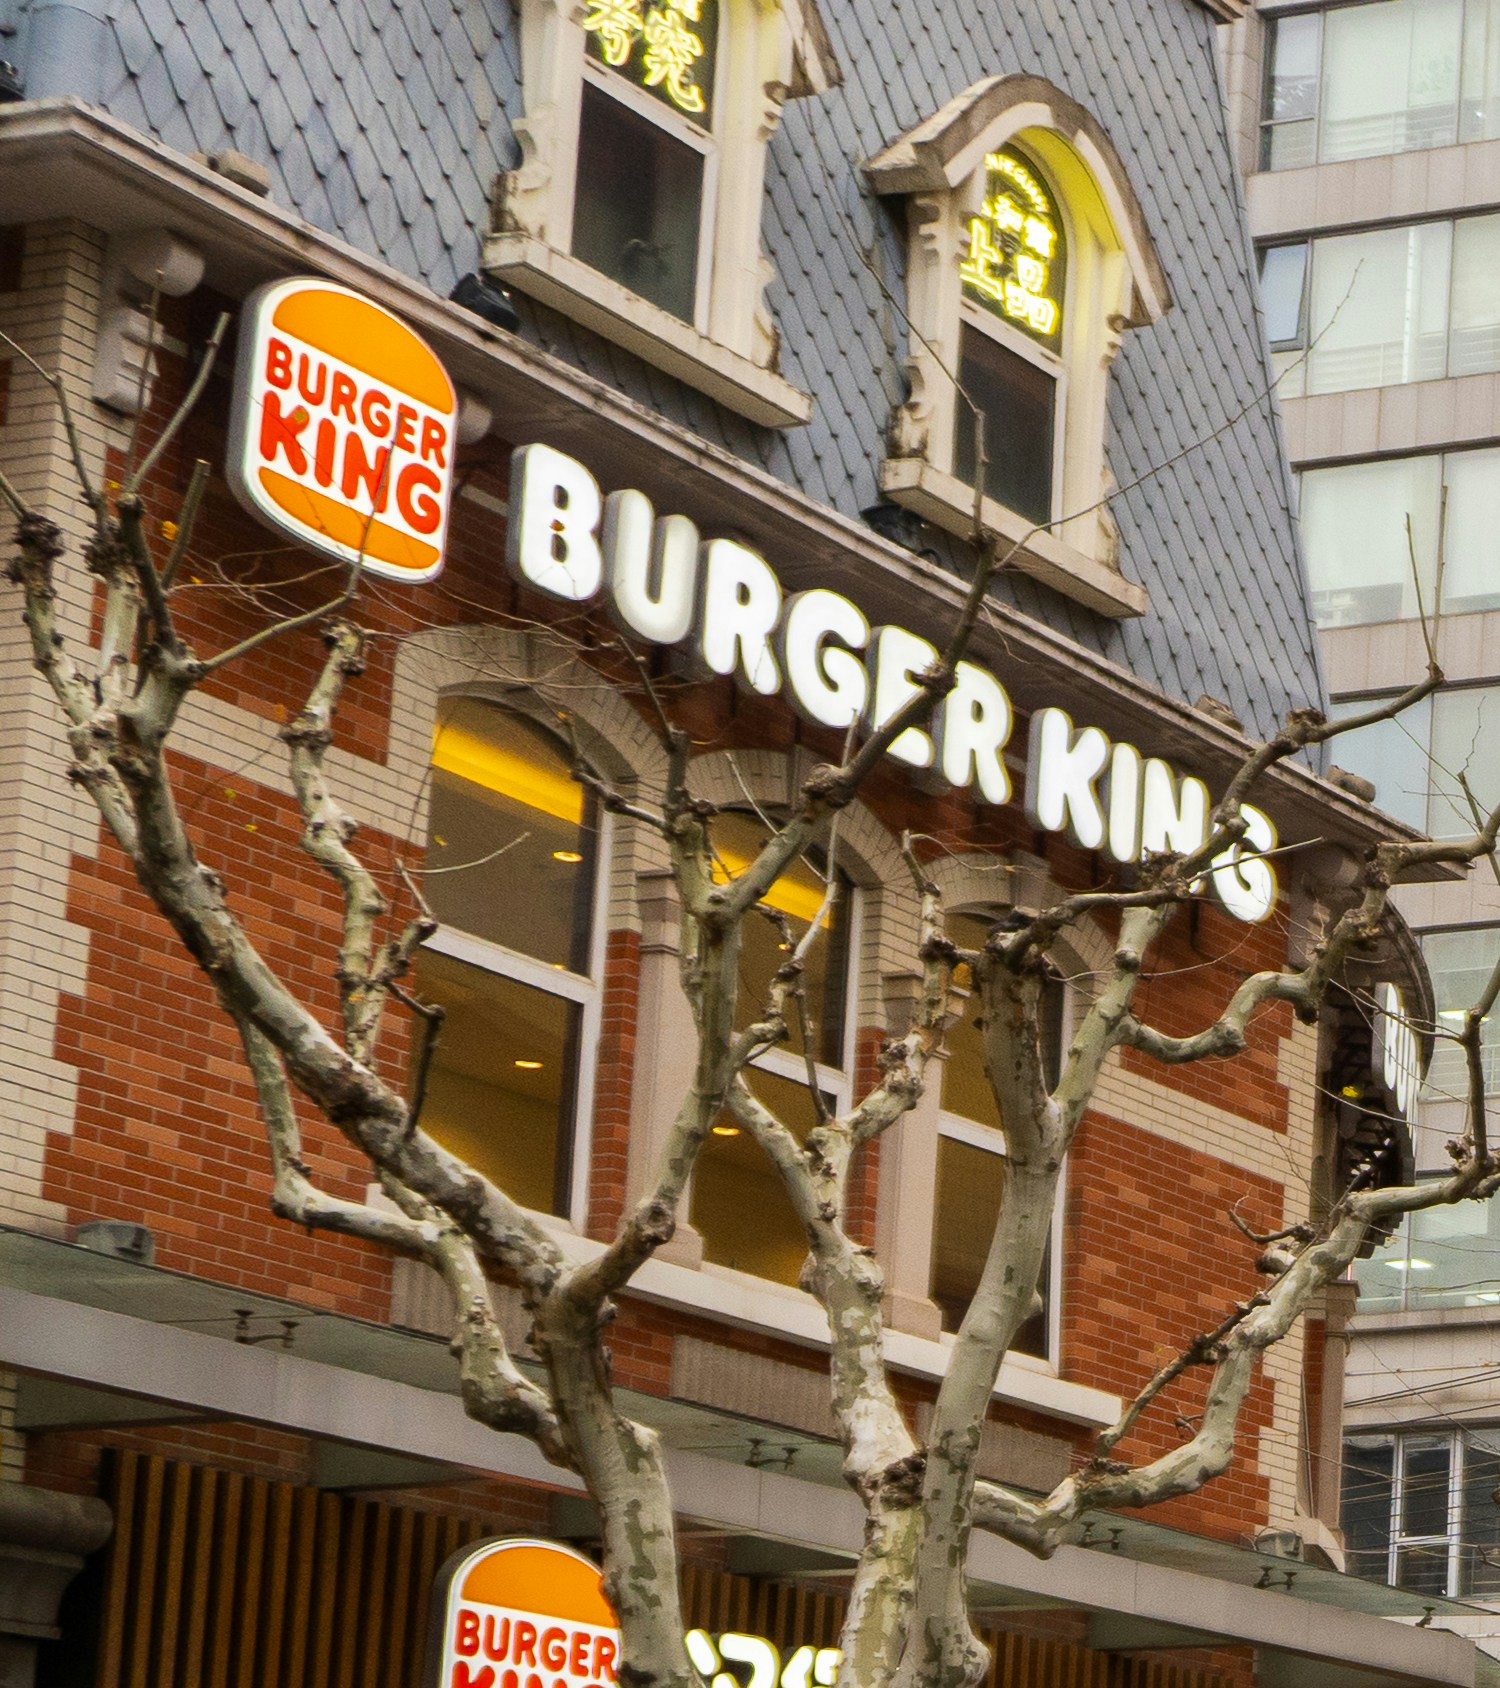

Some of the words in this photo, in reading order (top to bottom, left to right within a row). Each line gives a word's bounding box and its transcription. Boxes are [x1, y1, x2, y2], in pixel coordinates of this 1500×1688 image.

[259, 390, 442, 535] KING
[265, 336, 448, 470] BURGER
[508, 442, 1012, 804] BURGER
[1026, 706, 1278, 924] KING
[454, 1608, 618, 1684] BURGER
